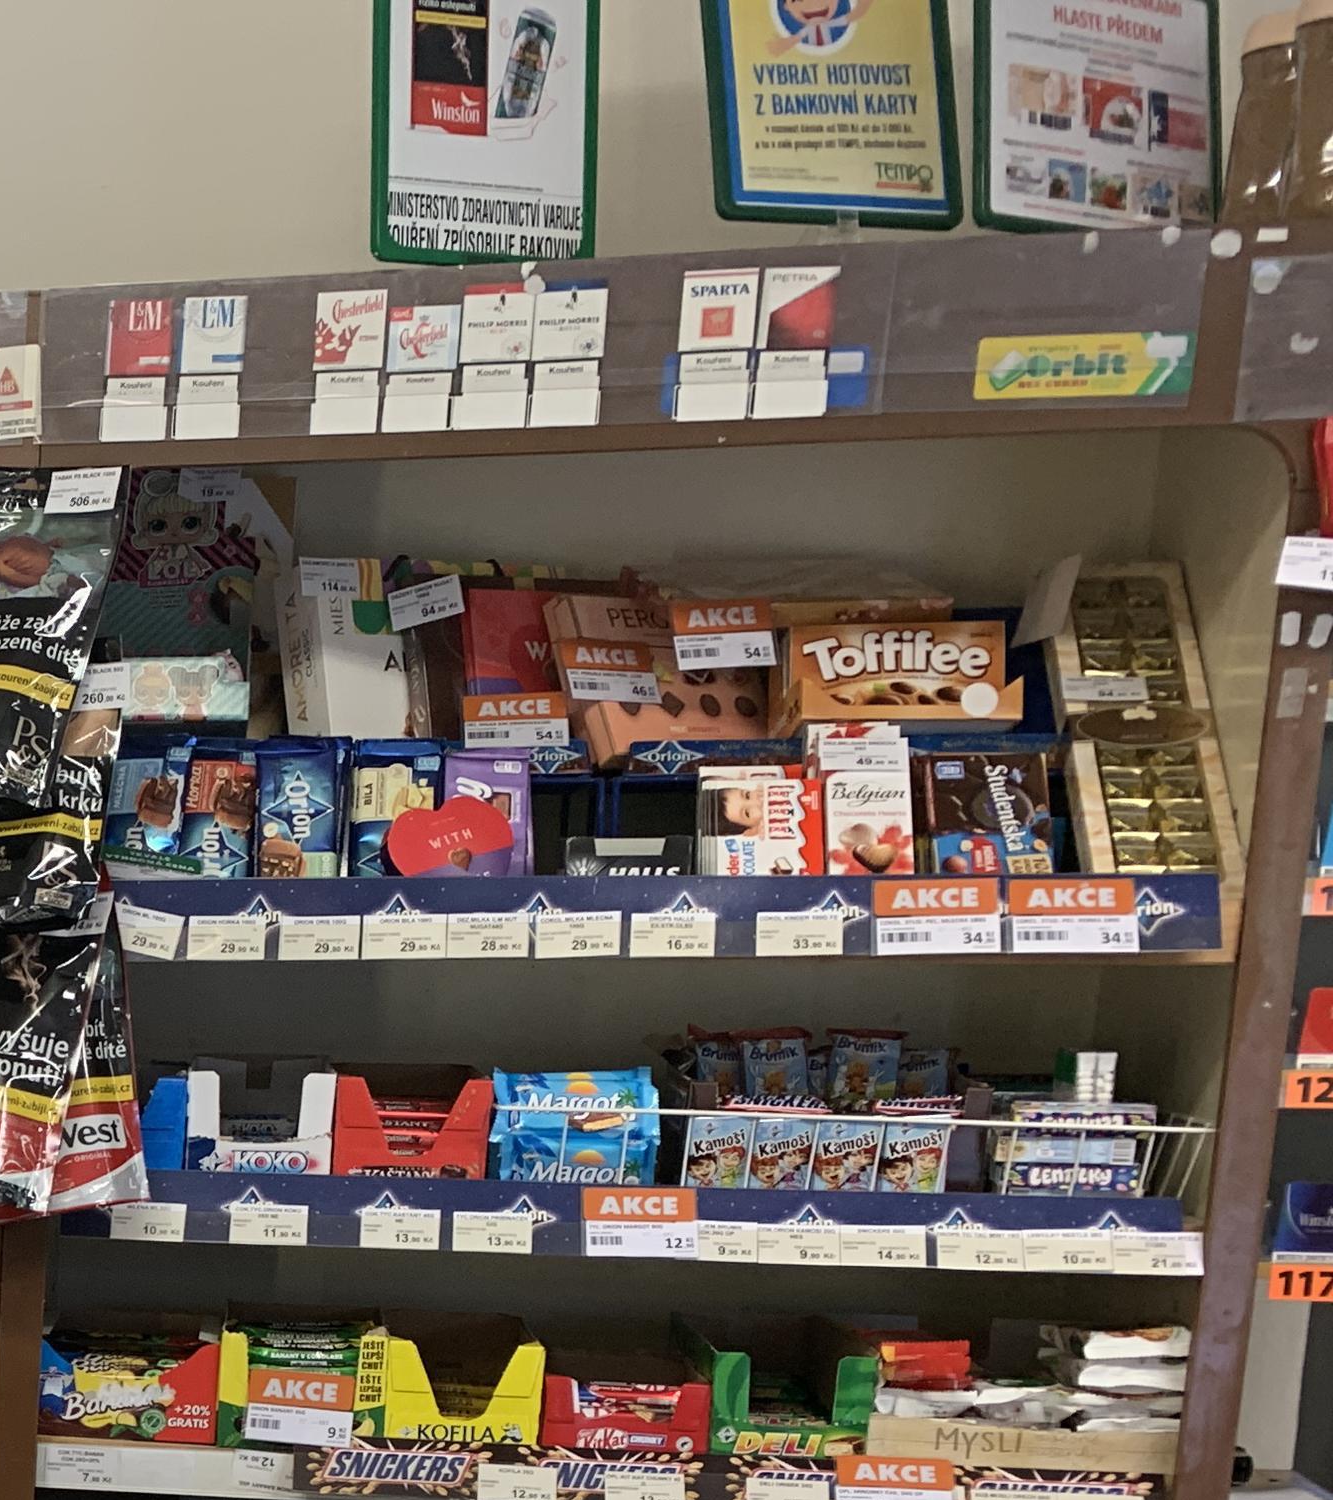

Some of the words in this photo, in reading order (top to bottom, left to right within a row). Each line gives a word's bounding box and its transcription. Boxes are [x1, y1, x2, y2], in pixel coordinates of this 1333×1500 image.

[1054, 9, 1107, 32] HLASTE
[754, 64, 818, 86] VYBRAT
[826, 65, 910, 86] HOTOVOST
[431, 99, 480, 123] Winston
[756, 93, 766, 114] Z
[771, 91, 858, 114] BANKOVNÍ
[864, 93, 917, 116] KARTY
[693, 283, 750, 297] SPARTA
[128, 302, 161, 331] L&M
[202, 298, 234, 328] L&M
[333, 298, 384, 323] Chesterfield
[1025, 354, 1126, 378] Orbit
[804, 631, 989, 679] Toffifee
[478, 700, 550, 717] AKCE
[648, 749, 692, 763] Orion
[832, 782, 904, 806] Belgian
[429, 827, 473, 850] WITH
[892, 888, 979, 910] AKCE
[528, 1091, 619, 1120] Margot
[234, 1151, 308, 1173] KOKO
[601, 1195, 673, 1216] AKCE
[263, 1380, 336, 1401] AKCE
[417, 1424, 493, 1443] KOFILA
[735, 1432, 820, 1457] DELI
[935, 1428, 1027, 1459] MYSLI
[328, 1451, 467, 1483] SNICKERS
